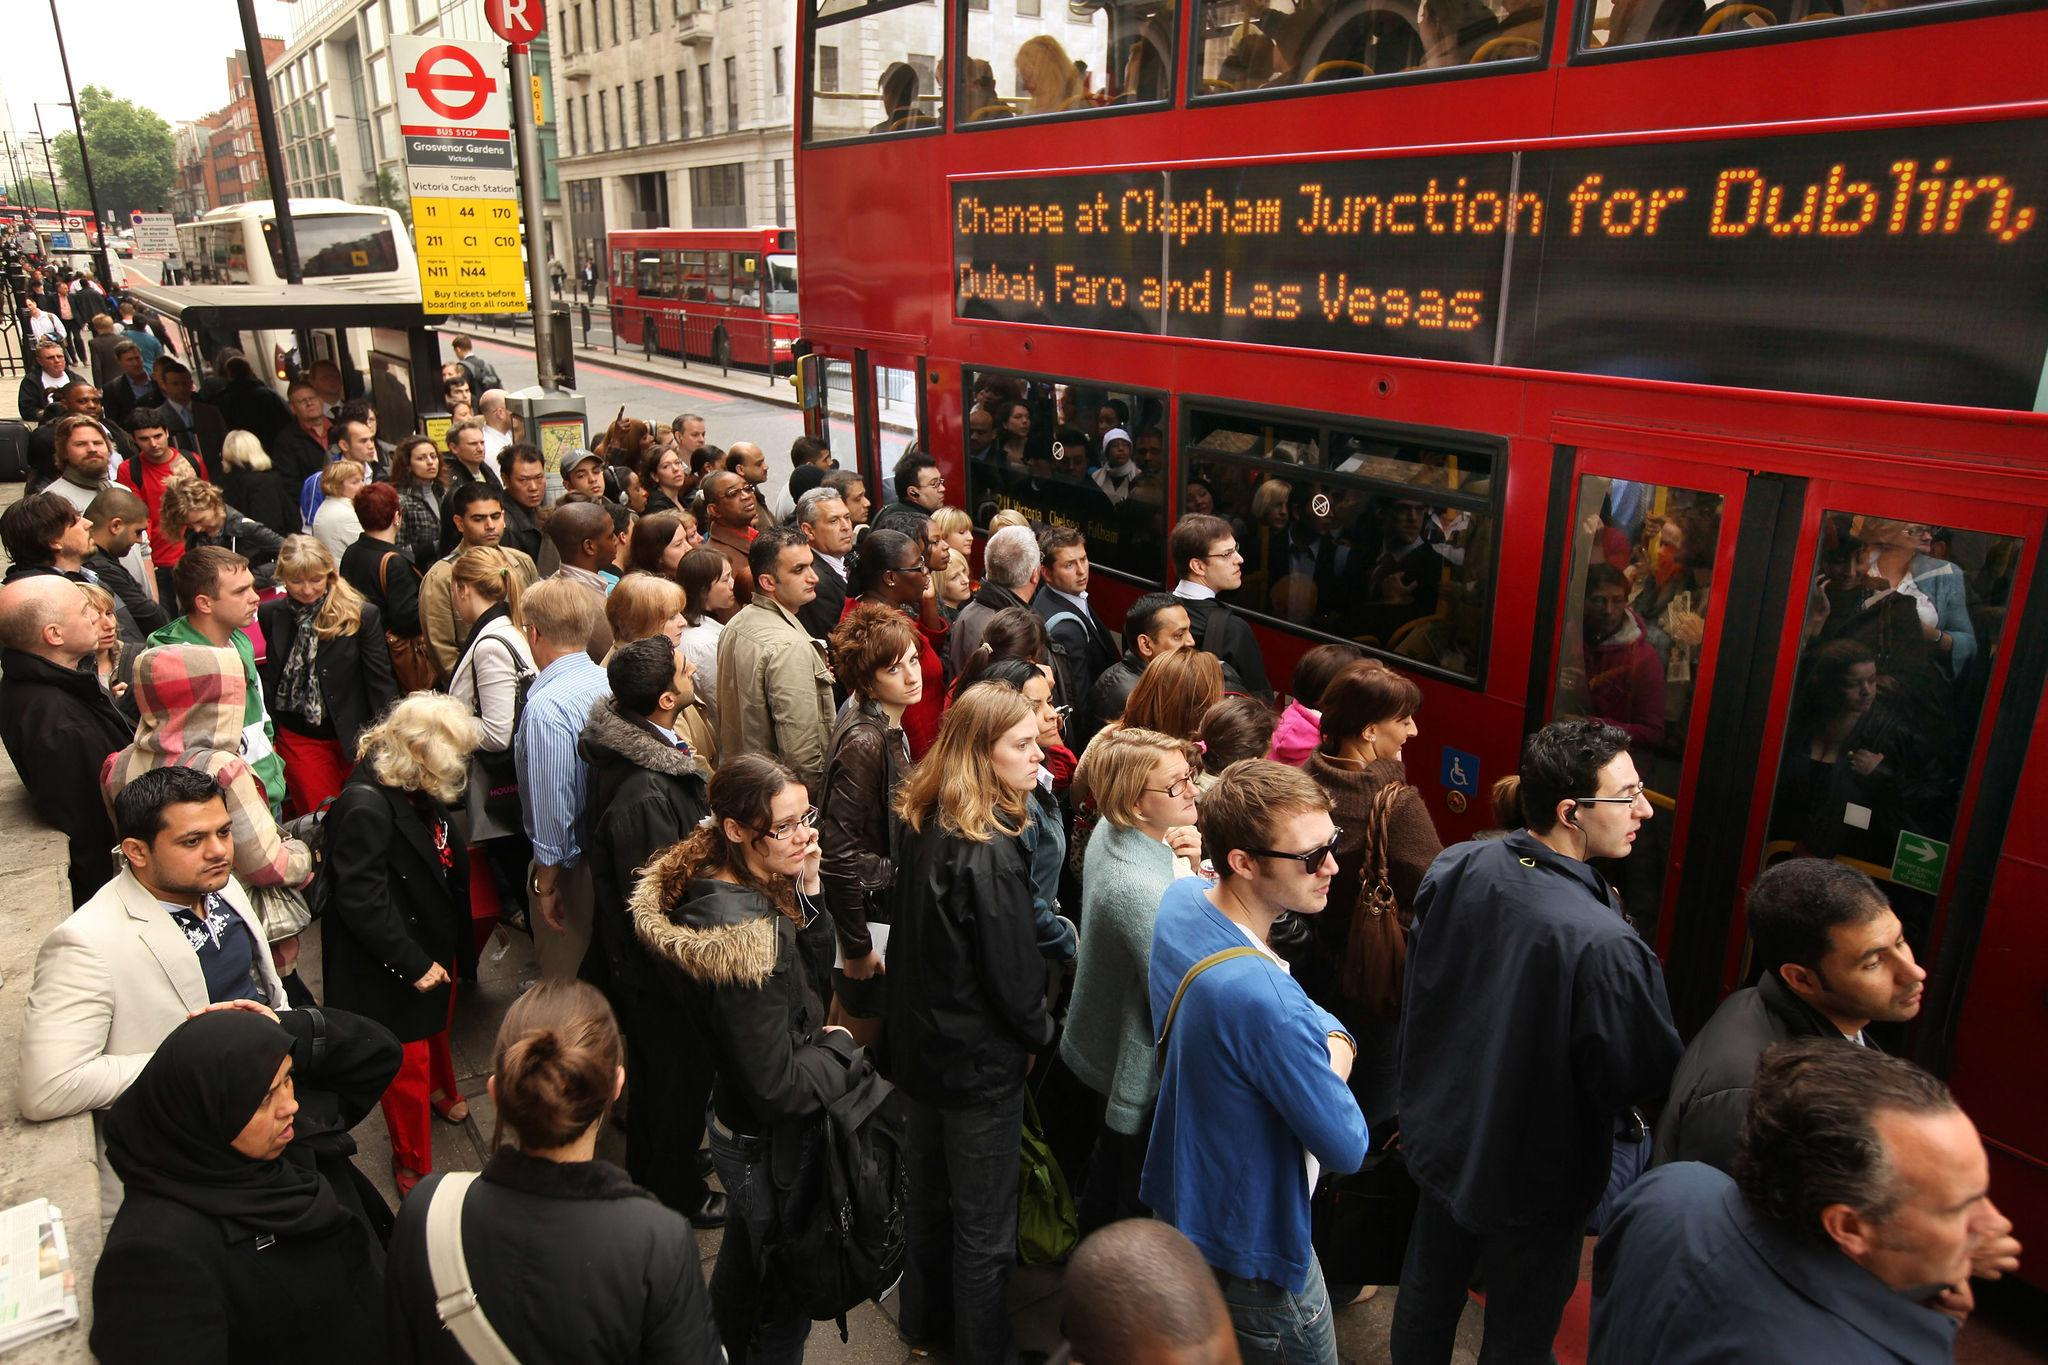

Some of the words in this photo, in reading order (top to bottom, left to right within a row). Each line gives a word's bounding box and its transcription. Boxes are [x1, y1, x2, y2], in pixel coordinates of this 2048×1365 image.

[502, 0, 533, 31] R
[436, 128, 453, 136] BUS
[456, 128, 478, 137] STOP
[413, 142, 463, 153] Grosvenor
[466, 144, 505, 155] Gardens
[448, 155, 474, 163] Victoria
[412, 182, 449, 191] Victoria
[452, 183, 480, 192] Coach
[483, 184, 514, 193] Station
[1075, 191, 1109, 234] at
[1120, 188, 1281, 246] Clapham
[1298, 177, 1542, 236] Junction
[1568, 174, 1688, 236] for
[1709, 158, 2037, 243] Dublin,
[426, 206, 437, 217] 11
[459, 207, 475, 217] 44
[492, 208, 511, 219] 170
[426, 236, 443, 246] 211
[463, 236, 477, 246] C1
[494, 237, 515, 247] C10
[428, 267, 448, 277] N11
[461, 267, 486, 277] N44
[434, 290, 451, 299] Buy
[454, 290, 485, 298] tickets
[487, 289, 516, 298] before
[959, 263, 1044, 309] Dubai,
[1055, 263, 1126, 308] Faro
[1139, 268, 1210, 313] and
[1224, 270, 1301, 320] Las
[1318, 272, 1484, 330] Vegas
[427, 300, 468, 310] boarding
